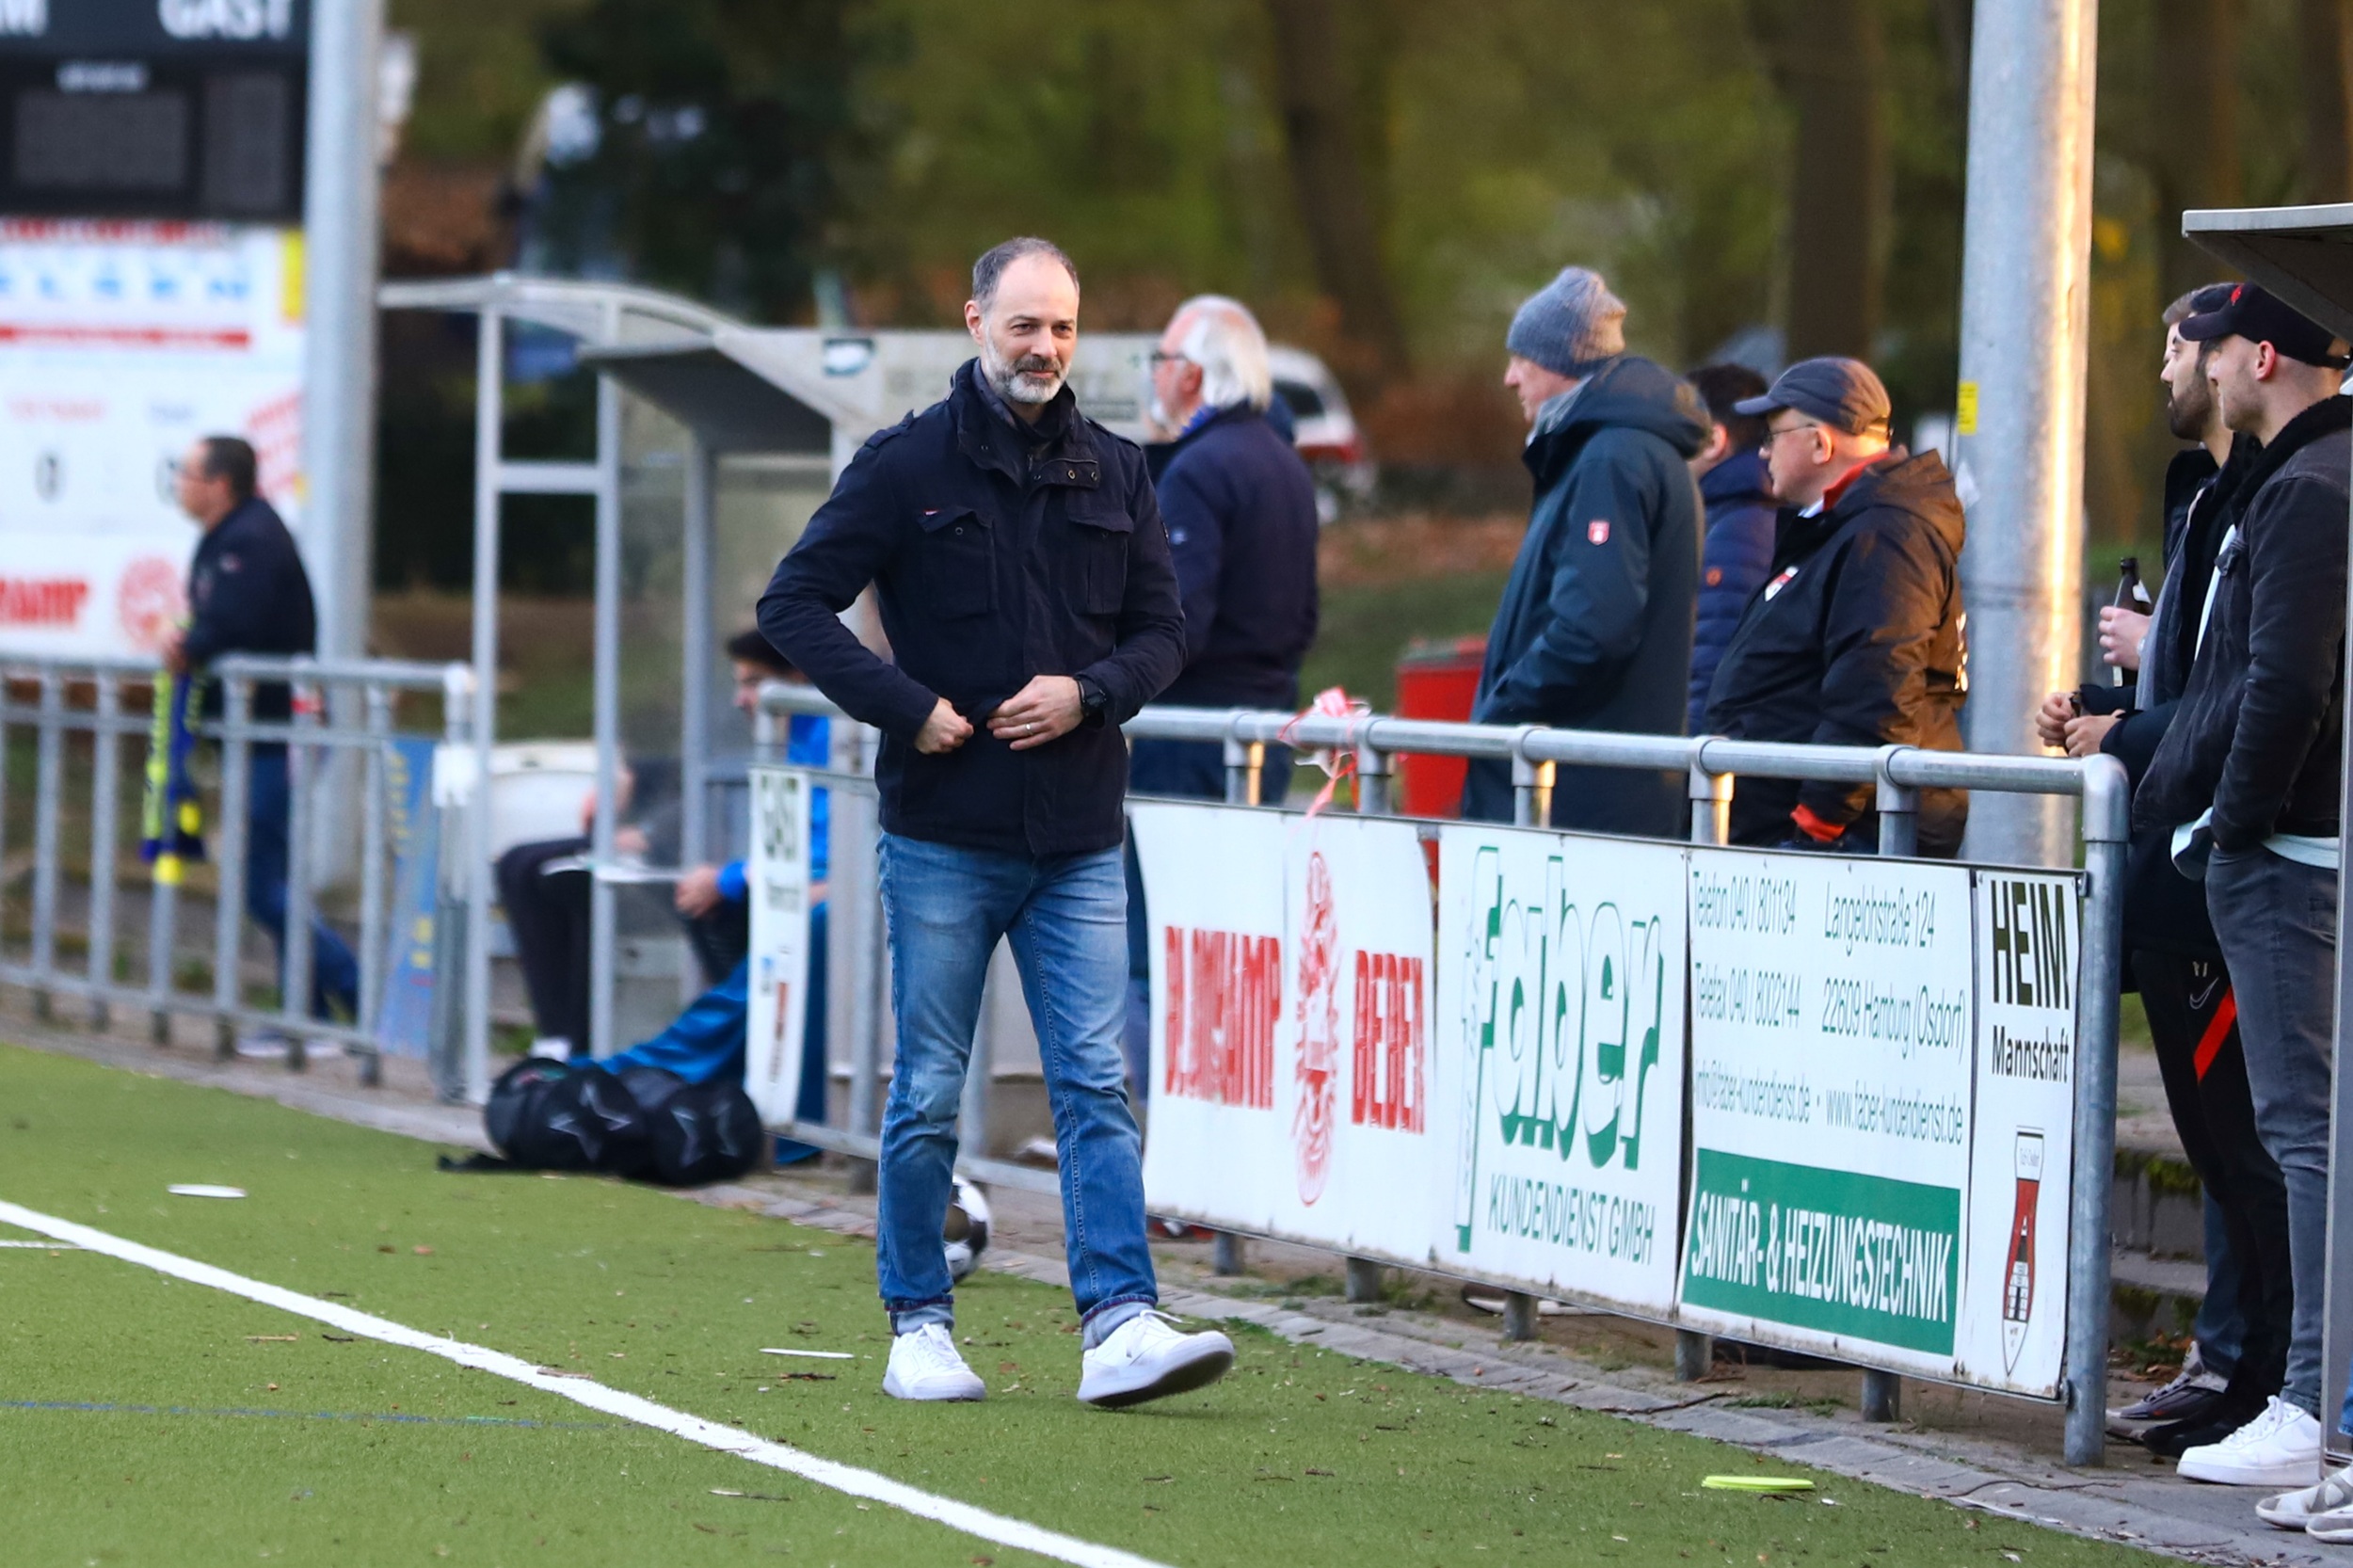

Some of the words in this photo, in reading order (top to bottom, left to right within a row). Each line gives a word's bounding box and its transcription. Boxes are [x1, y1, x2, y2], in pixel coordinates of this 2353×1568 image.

[1692, 872, 1728, 929] Telefon
[1729, 875, 1750, 931] 040
[1757, 877, 1797, 936] 801134
[1824, 881, 1911, 957] Langelohstraße
[1914, 889, 1936, 949] 124
[1990, 878, 2071, 1011] HEIM
[1695, 962, 1728, 1020] Telefax
[1728, 968, 1748, 1025] 040
[1755, 969, 1801, 1030] 8002144
[1821, 976, 1862, 1037] 22609
[1863, 980, 1912, 1060] Hamburg
[1913, 984, 1966, 1064] (Osdorf)
[1456, 844, 1664, 1254] faber
[1991, 1024, 2071, 1083] Mannschaft
[1487, 1173, 1609, 1255] KUNDENDIENST
[1608, 1195, 1657, 1266] GMBH
[1690, 1177, 1764, 1288] SANITÄR-
[1765, 1202, 1782, 1294] &
[1782, 1207, 1953, 1323] HEIZUNGSTECHNIK
